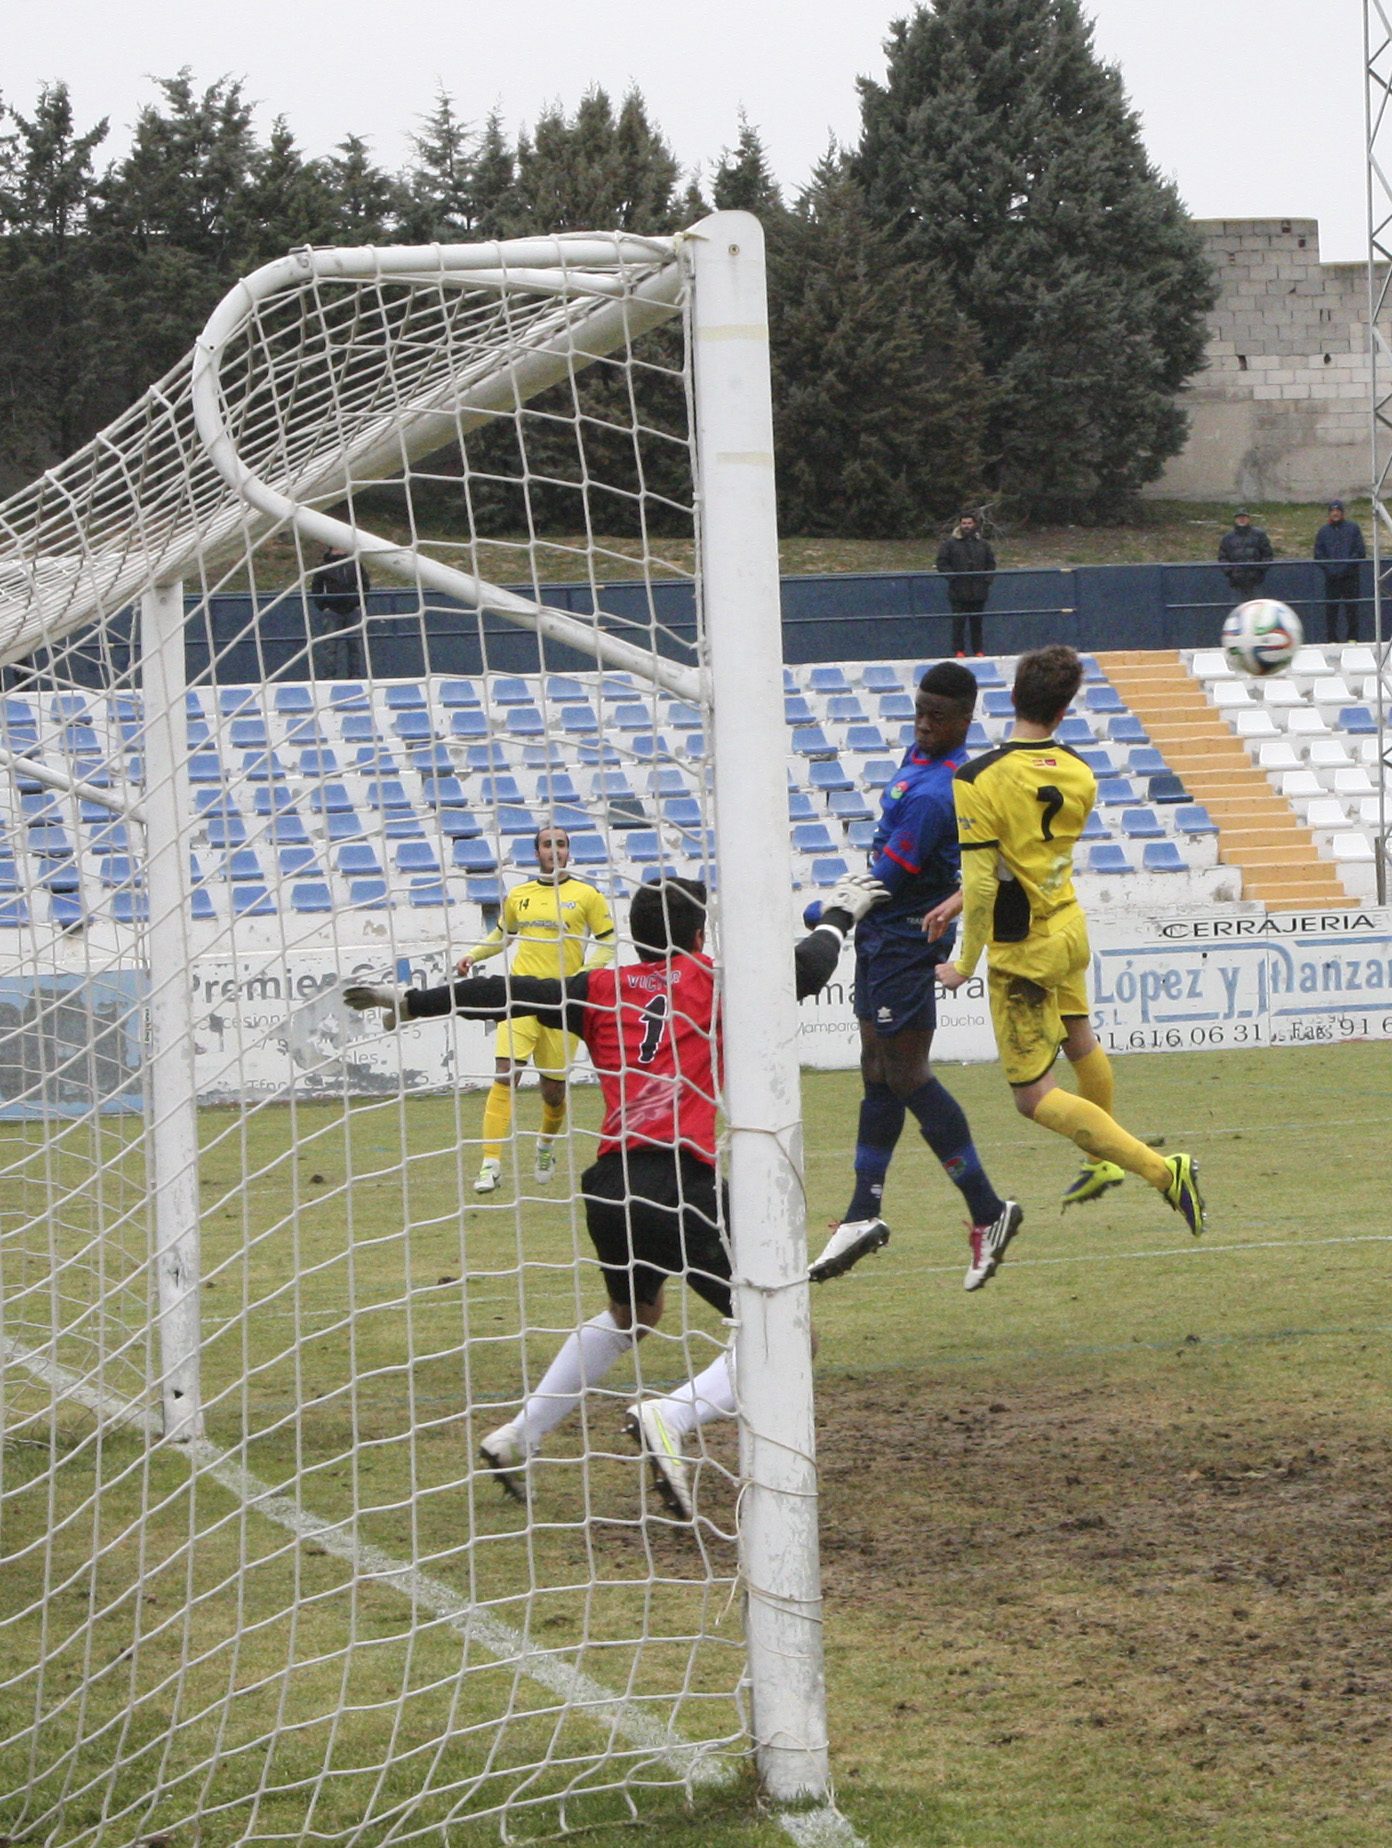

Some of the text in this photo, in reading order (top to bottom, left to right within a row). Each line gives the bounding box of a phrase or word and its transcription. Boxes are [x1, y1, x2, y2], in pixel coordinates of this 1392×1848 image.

[518, 898, 530, 911] 14
[1163, 914, 1376, 939] CERRAJERIA
[1093, 952, 1205, 1024] López
[1217, 966, 1241, 1020] y
[637, 993, 669, 1065] 1
[940, 1014, 985, 1028] Ducha
[1190, 1025, 1224, 1044] 06
[1233, 1023, 1262, 1042] 31
[1340, 1018, 1370, 1037] 91
